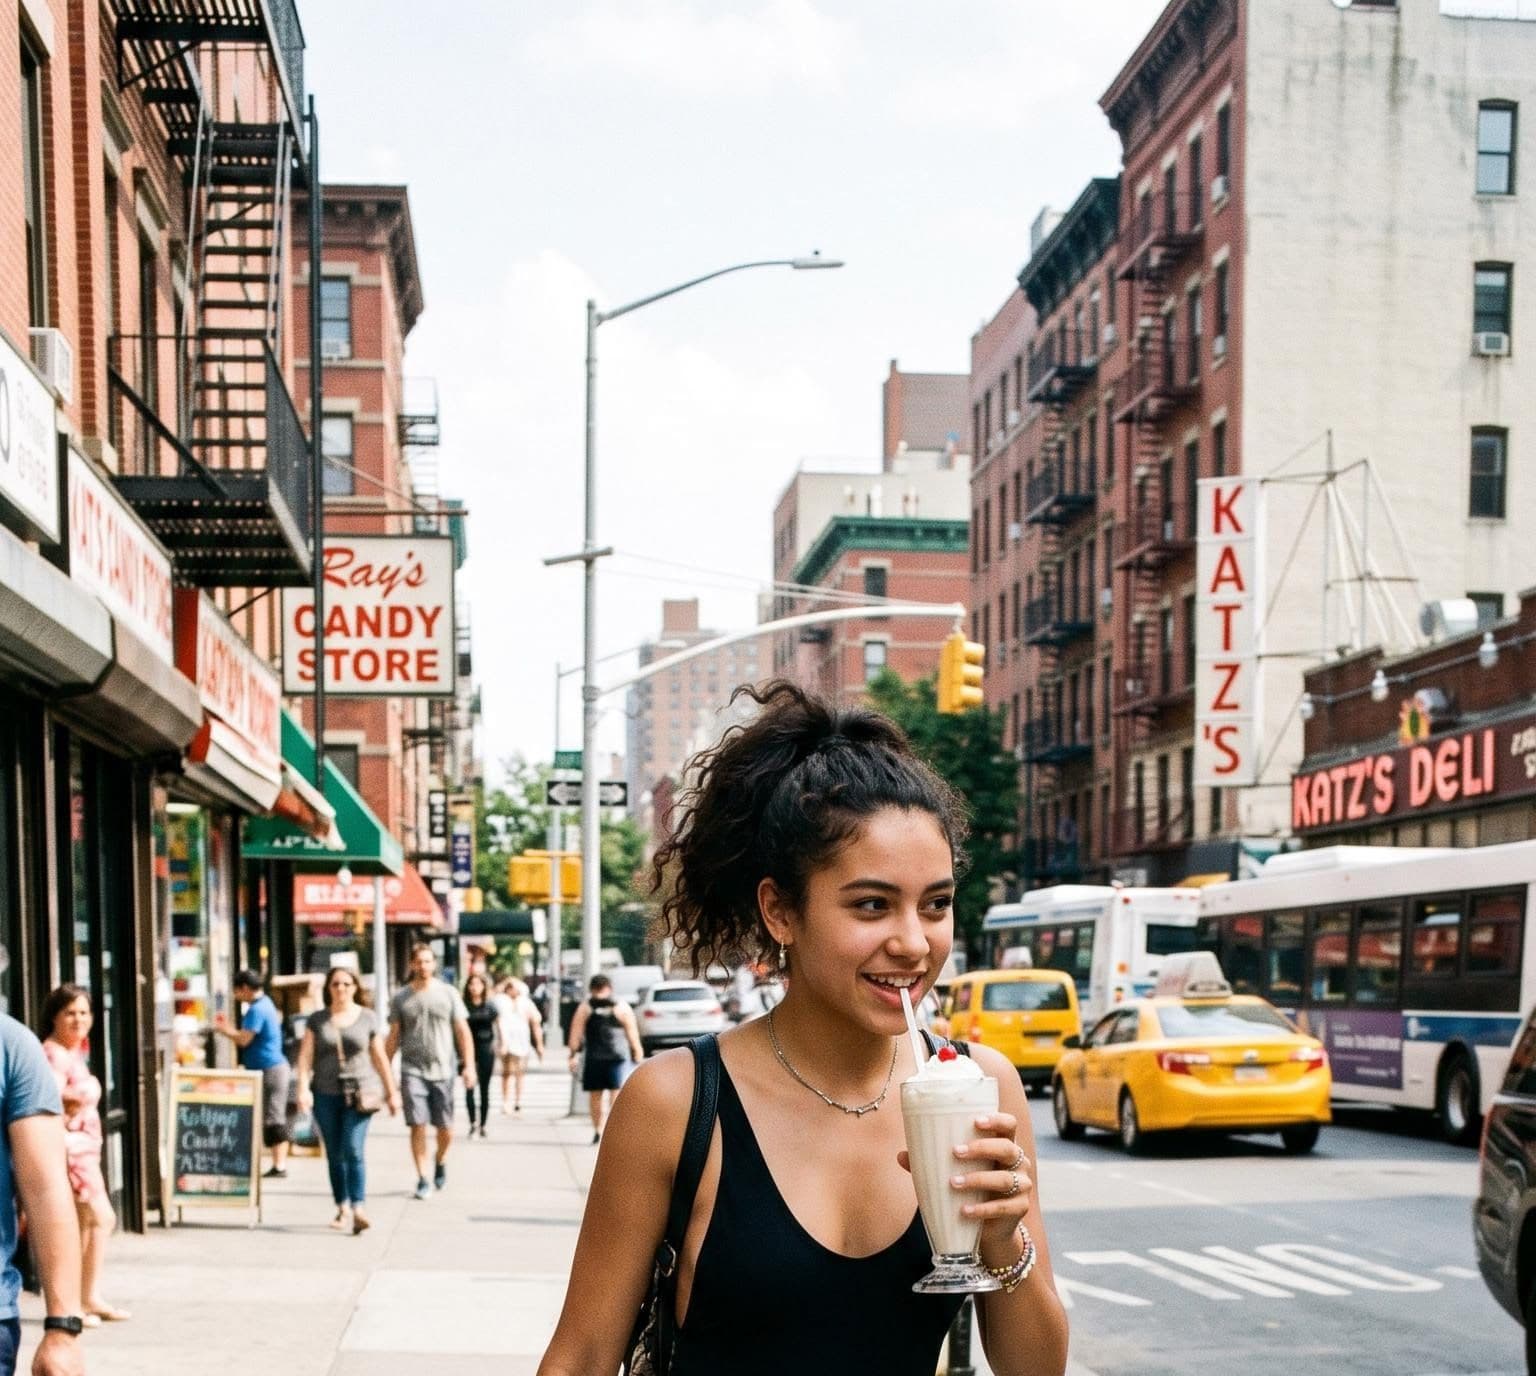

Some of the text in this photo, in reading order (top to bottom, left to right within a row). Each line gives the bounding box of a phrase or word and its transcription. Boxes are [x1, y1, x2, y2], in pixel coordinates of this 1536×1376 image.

[321, 546, 427, 599] Ray's
[293, 604, 443, 639] CANDY
[1204, 484, 1245, 775] KATZ'S
[296, 648, 440, 683] STORE
[1293, 755, 1395, 829] KATZ'S
[1409, 728, 1495, 807] DELI
